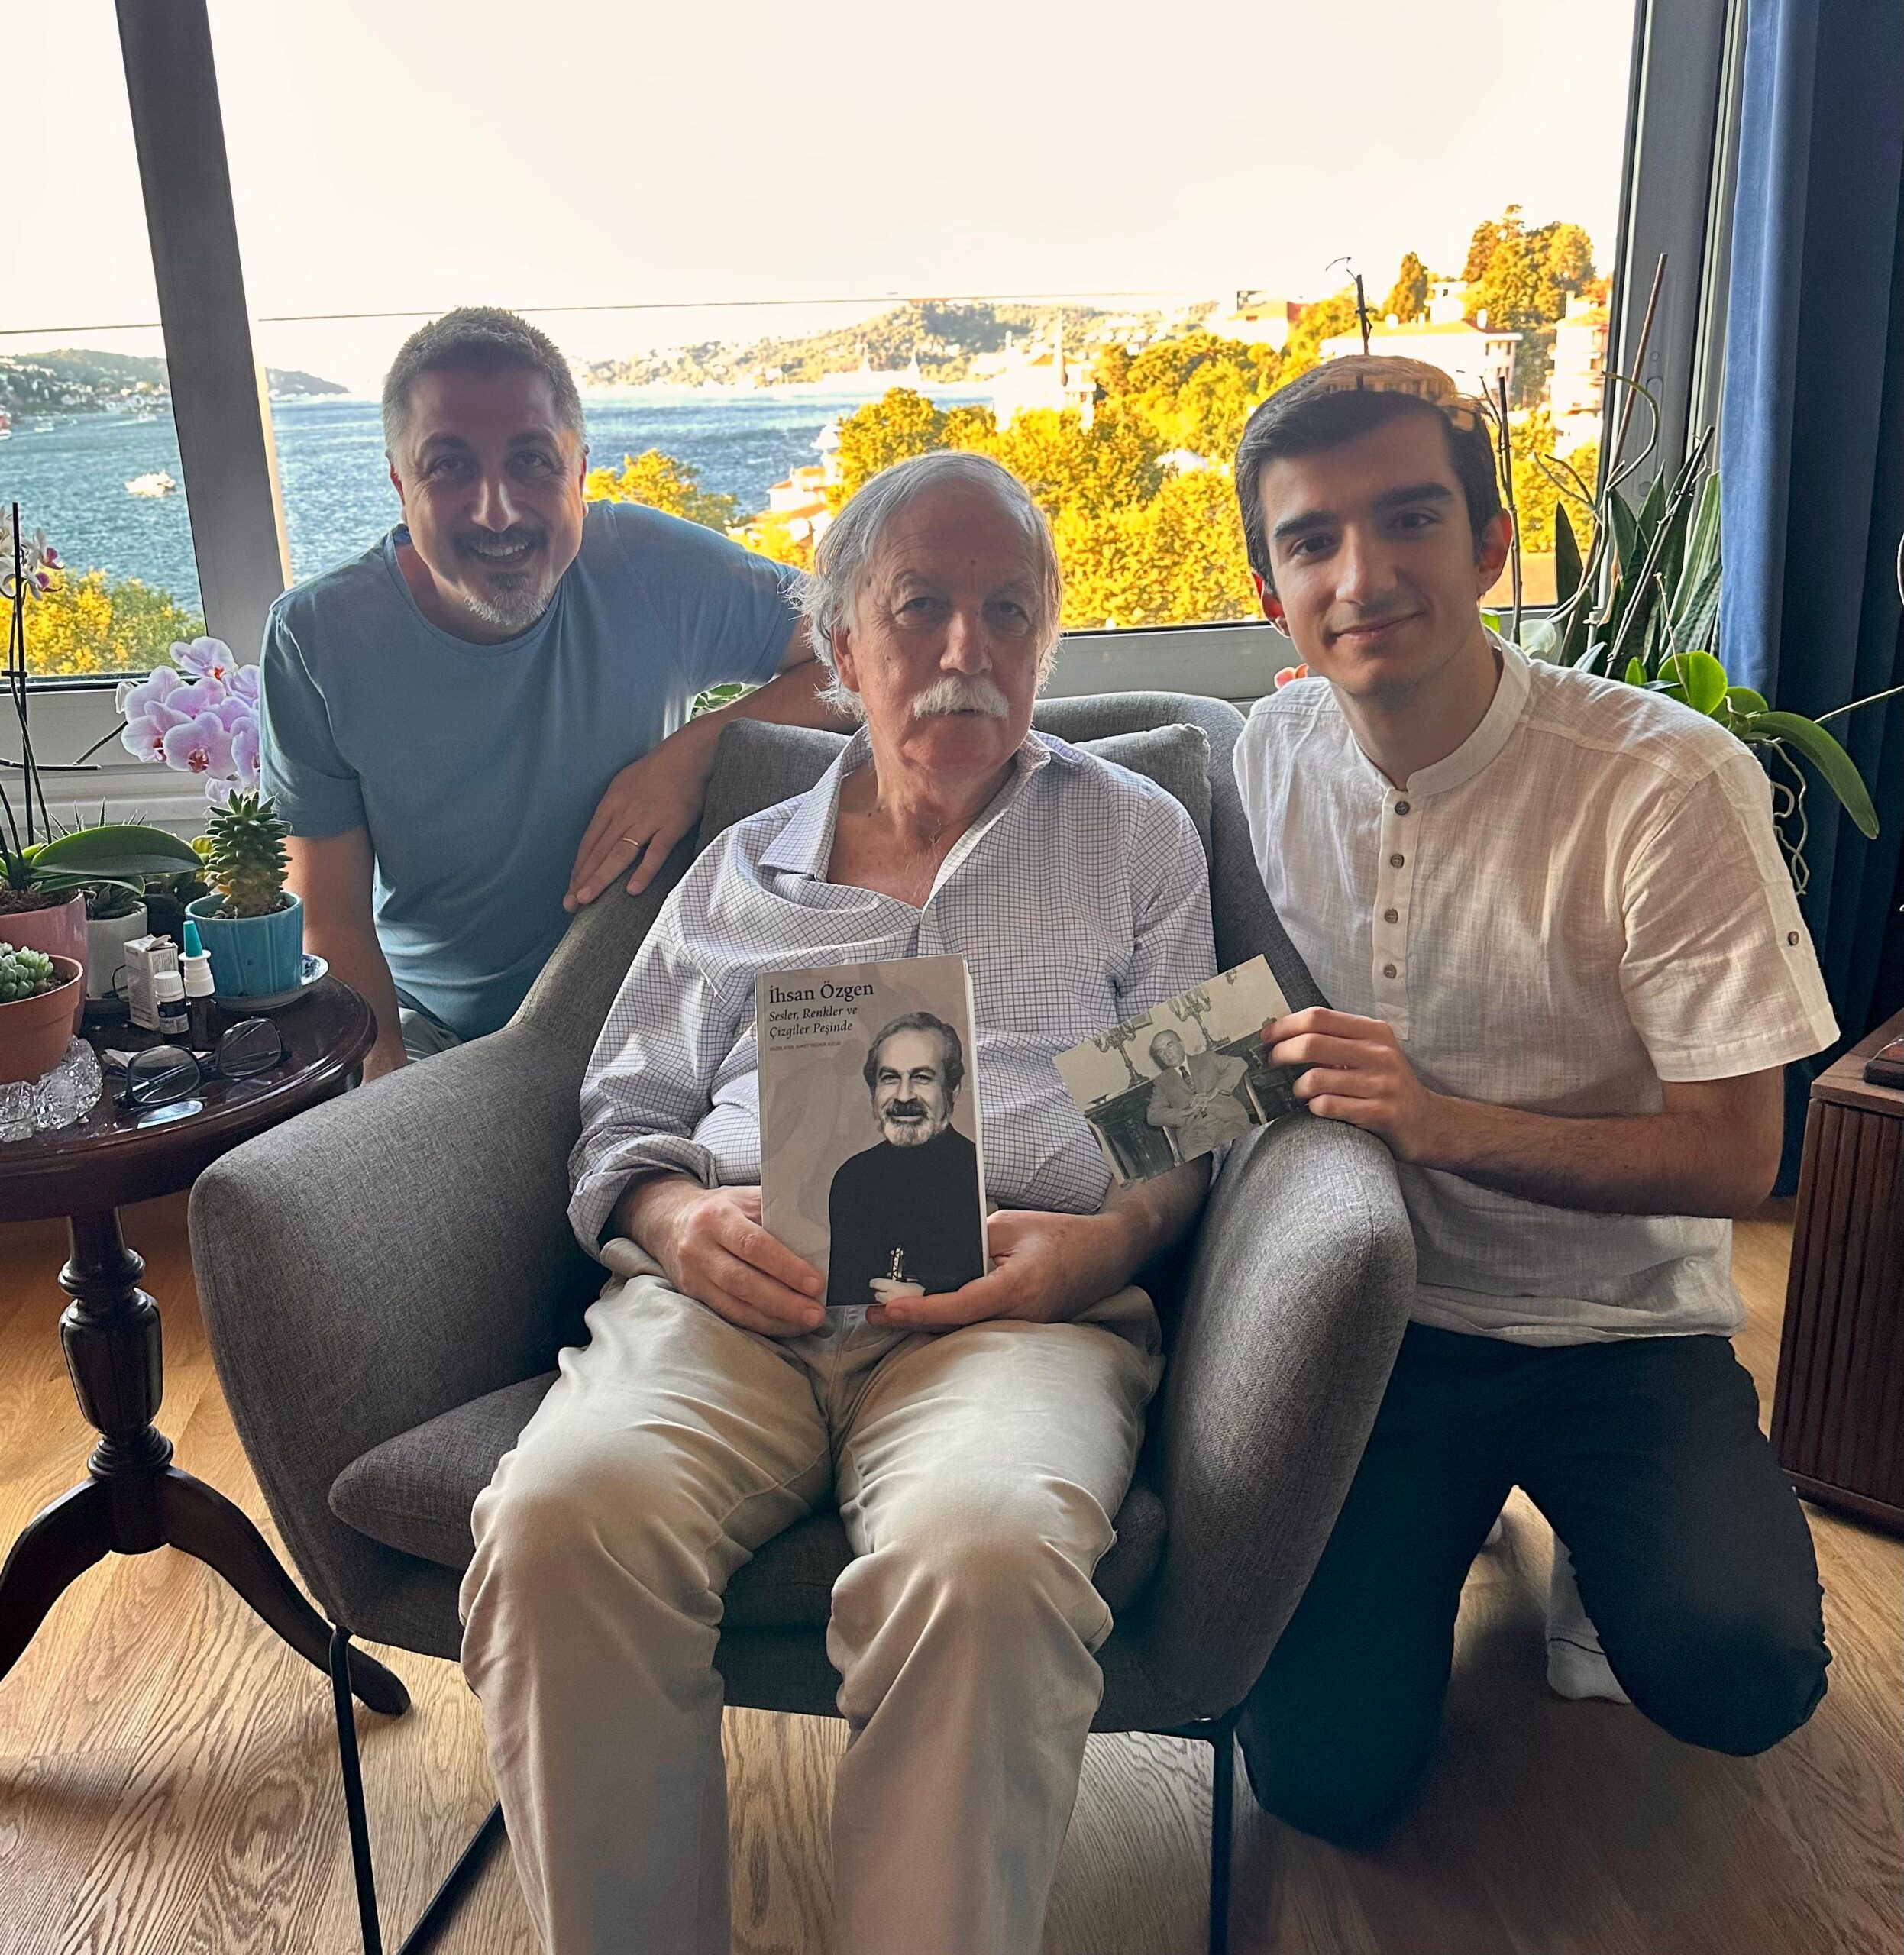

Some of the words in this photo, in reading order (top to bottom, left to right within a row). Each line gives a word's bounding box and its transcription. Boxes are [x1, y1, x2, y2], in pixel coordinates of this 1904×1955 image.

[769, 985, 814, 1003] İhsan
[820, 981, 874, 1002] Özgen
[769, 1010, 799, 1022] Sesler,
[803, 1006, 843, 1019] Renkler
[846, 1007, 858, 1015] ve
[770, 1024, 810, 1040] Çizgiler
[813, 1020, 853, 1035] Peşinde
